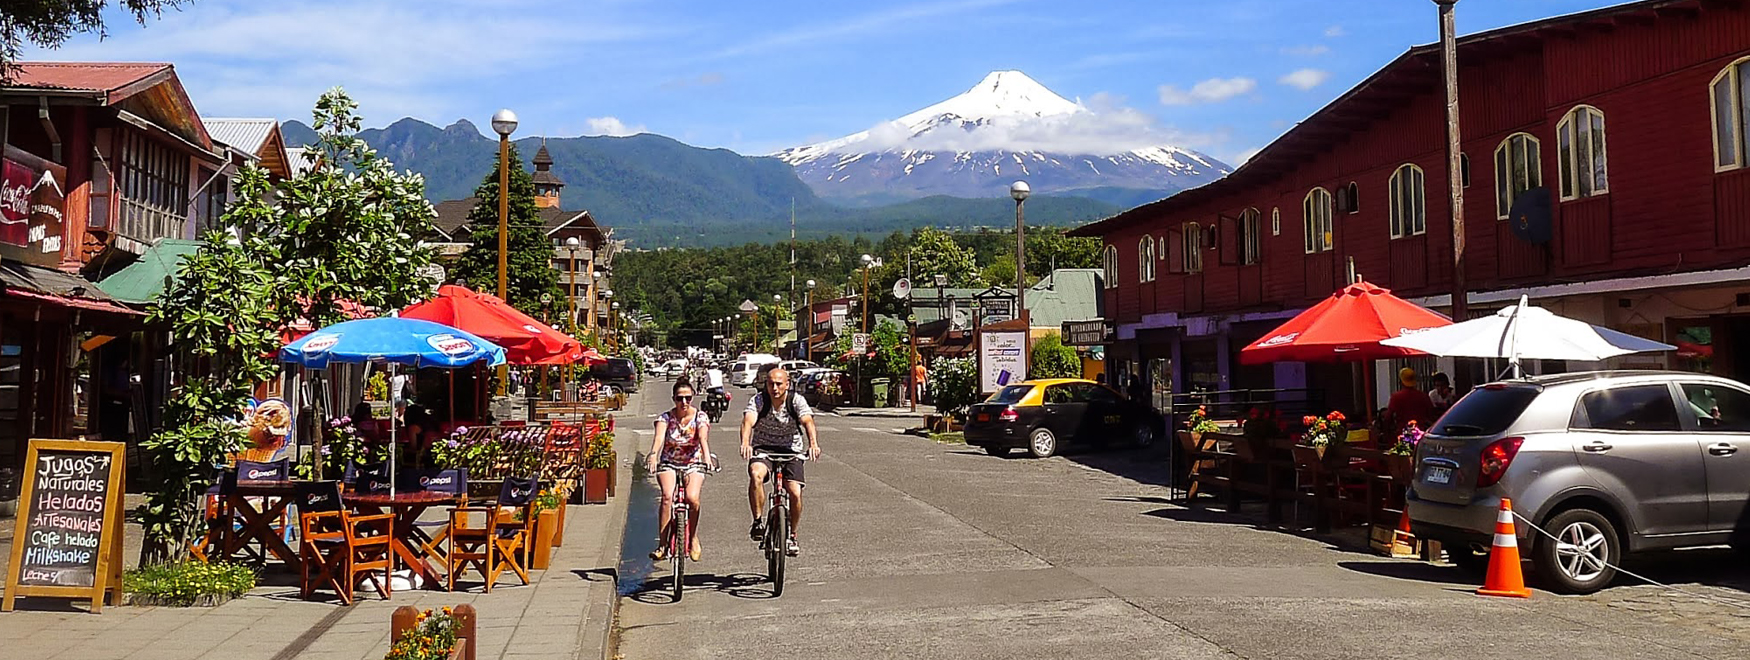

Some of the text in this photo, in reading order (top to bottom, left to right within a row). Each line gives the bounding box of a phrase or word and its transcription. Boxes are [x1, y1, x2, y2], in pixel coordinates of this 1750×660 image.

[257, 468, 278, 478] pepsi
[428, 476, 452, 486] pepsi
[38, 492, 104, 512] Helados
[31, 530, 99, 549] Cafe helado
[25, 547, 92, 565] Milkshake
